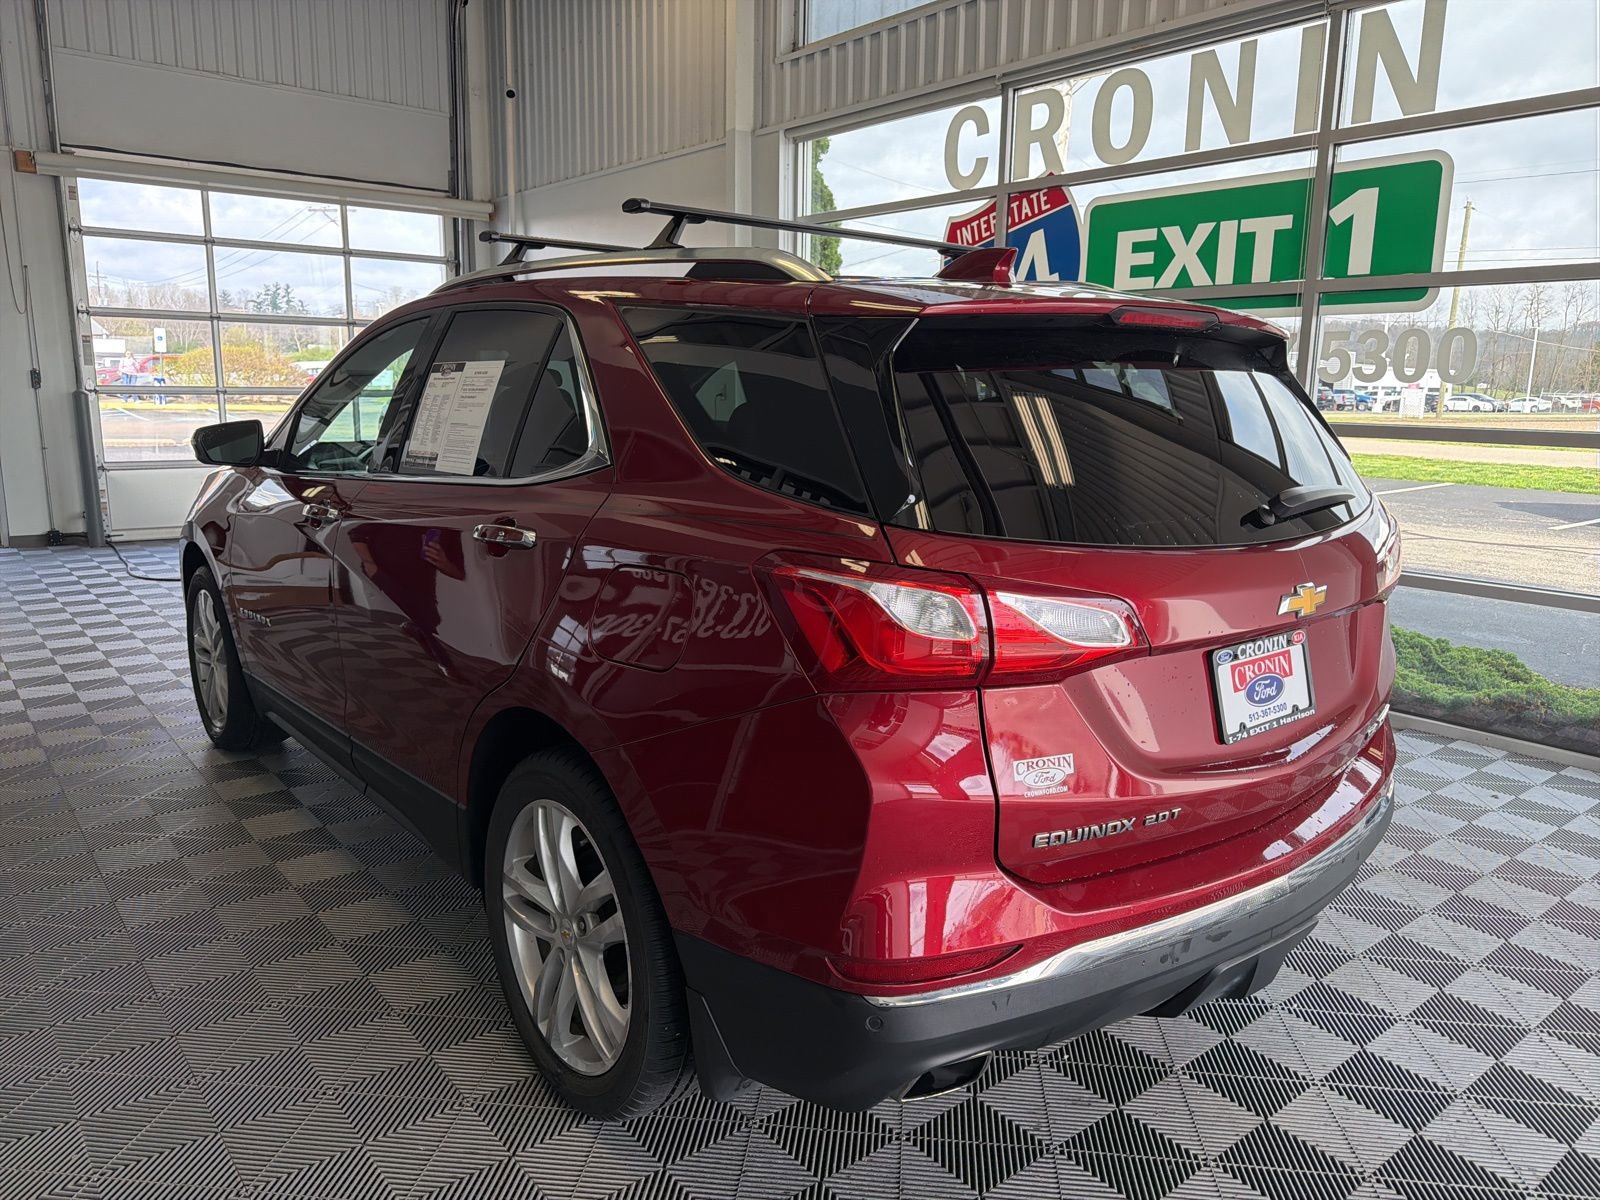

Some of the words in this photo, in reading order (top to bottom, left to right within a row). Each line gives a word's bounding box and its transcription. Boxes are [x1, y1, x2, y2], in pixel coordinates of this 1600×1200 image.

[944, 0, 1447, 191] CRONIN
[956, 189, 1051, 246] INTERTATE
[1115, 214, 1294, 290] EXIT
[1329, 187, 1380, 276] 1
[1237, 634, 1287, 660] CRONIN
[1234, 654, 1291, 690] CRONIN
[1254, 679, 1277, 701] Ford
[1228, 732, 1248, 744] I-74
[1250, 724, 1271, 736] EXIT
[1280, 709, 1316, 726] Harrison
[1249, 702, 1288, 723] 513-367-5300
[1015, 755, 1072, 776] CRONIN
[1033, 771, 1057, 784] Ford
[1032, 817, 1136, 849] EQUINOX
